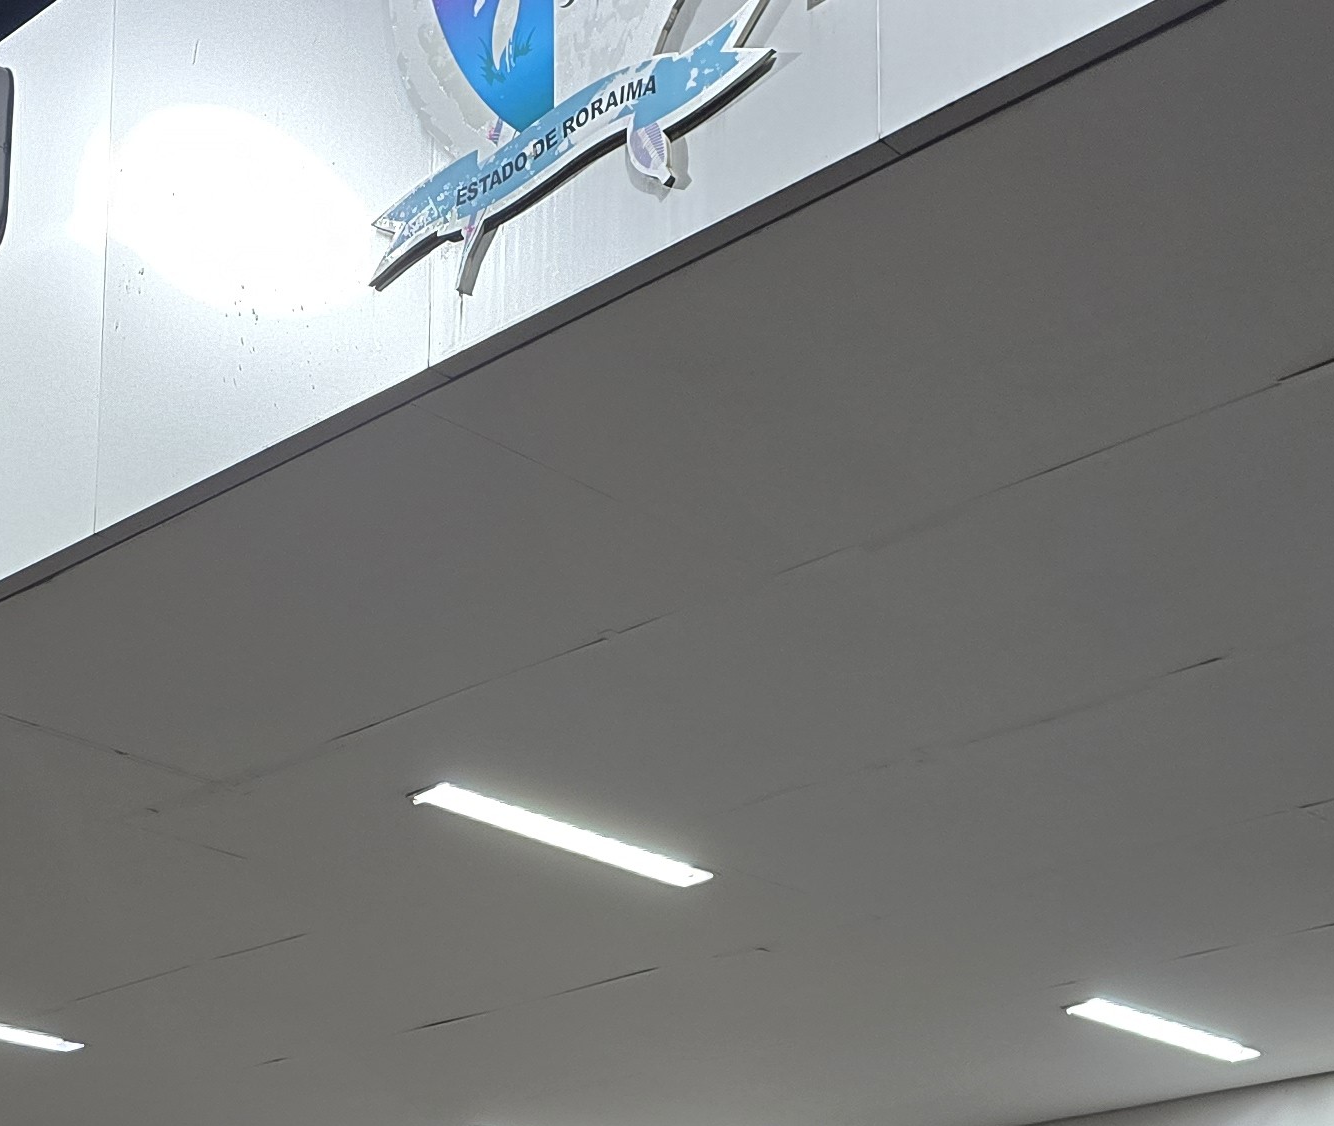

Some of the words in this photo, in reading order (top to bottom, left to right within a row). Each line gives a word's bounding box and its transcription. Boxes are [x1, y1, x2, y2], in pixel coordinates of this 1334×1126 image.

[455, 152, 527, 207] ESTADO
[531, 130, 558, 160] DE
[562, 75, 657, 139] RORAIMA
